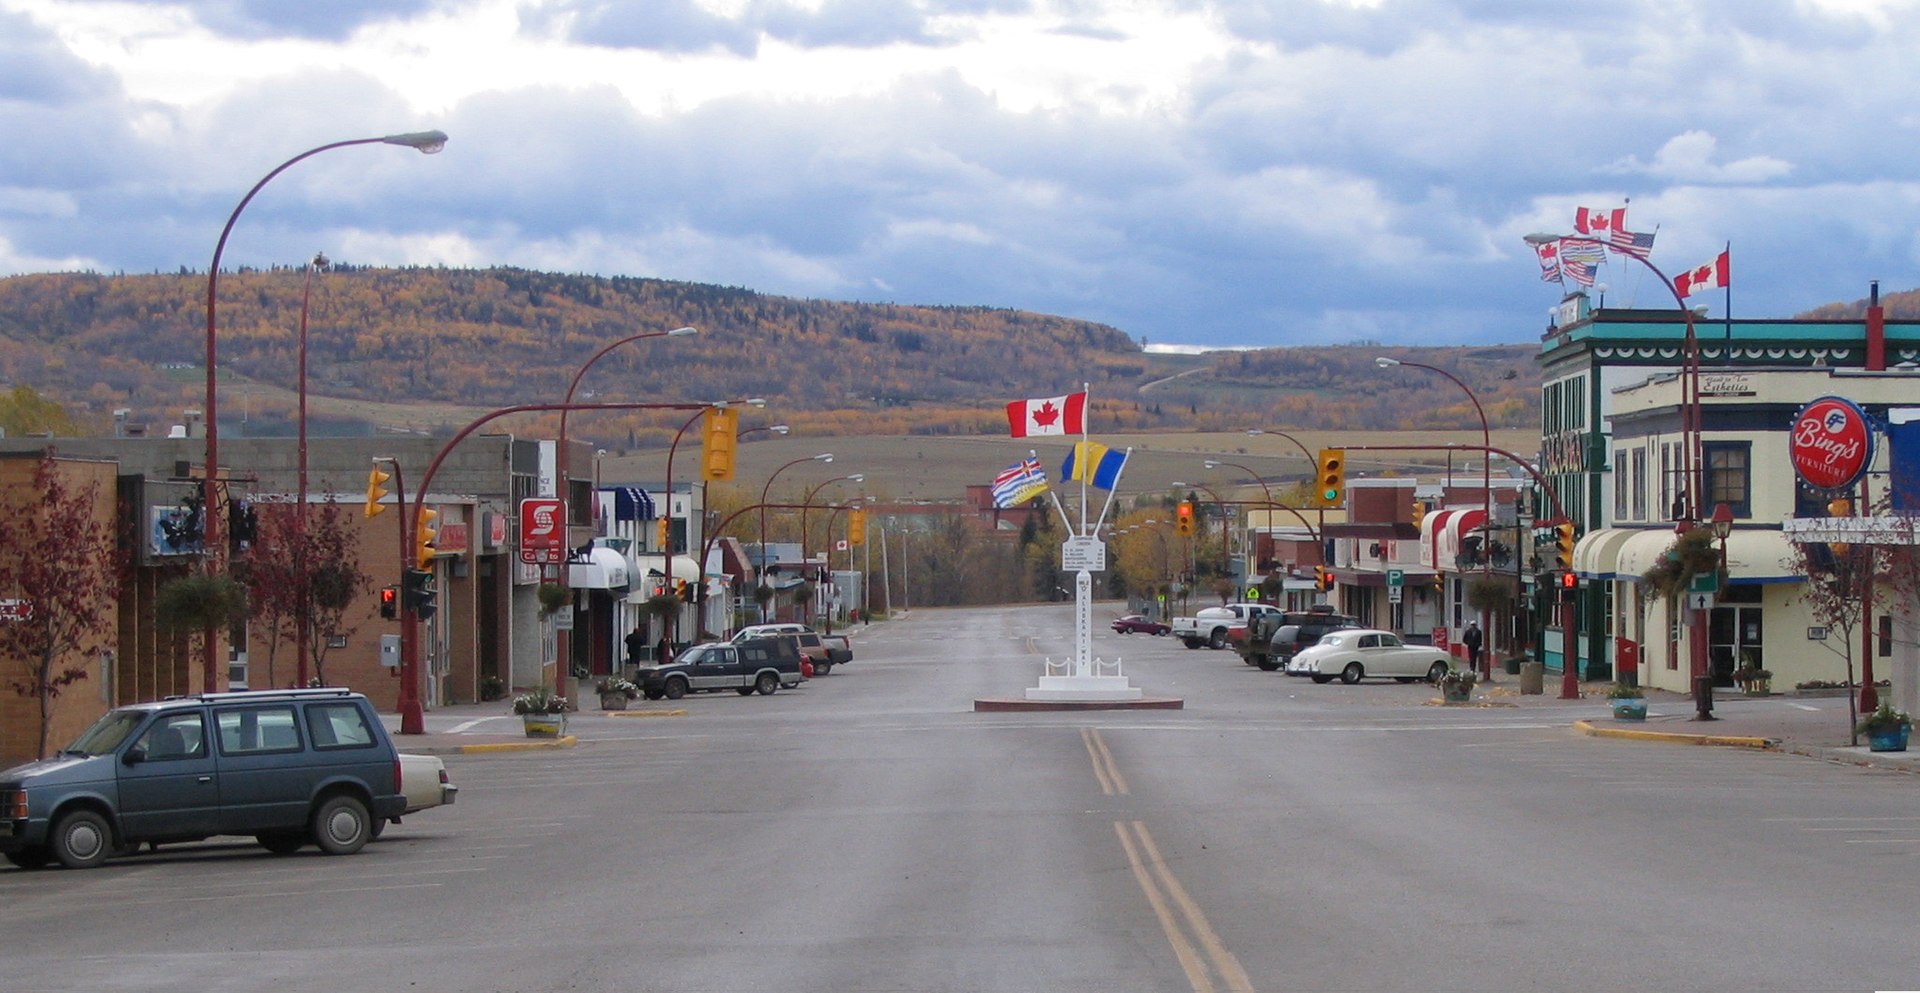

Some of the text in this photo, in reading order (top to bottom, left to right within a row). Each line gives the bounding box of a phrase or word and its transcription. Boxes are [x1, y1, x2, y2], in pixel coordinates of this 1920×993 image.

[1795, 418, 1860, 464] Bing's
[1796, 454, 1846, 477] FURNITURE
[1390, 571, 1401, 585] P
